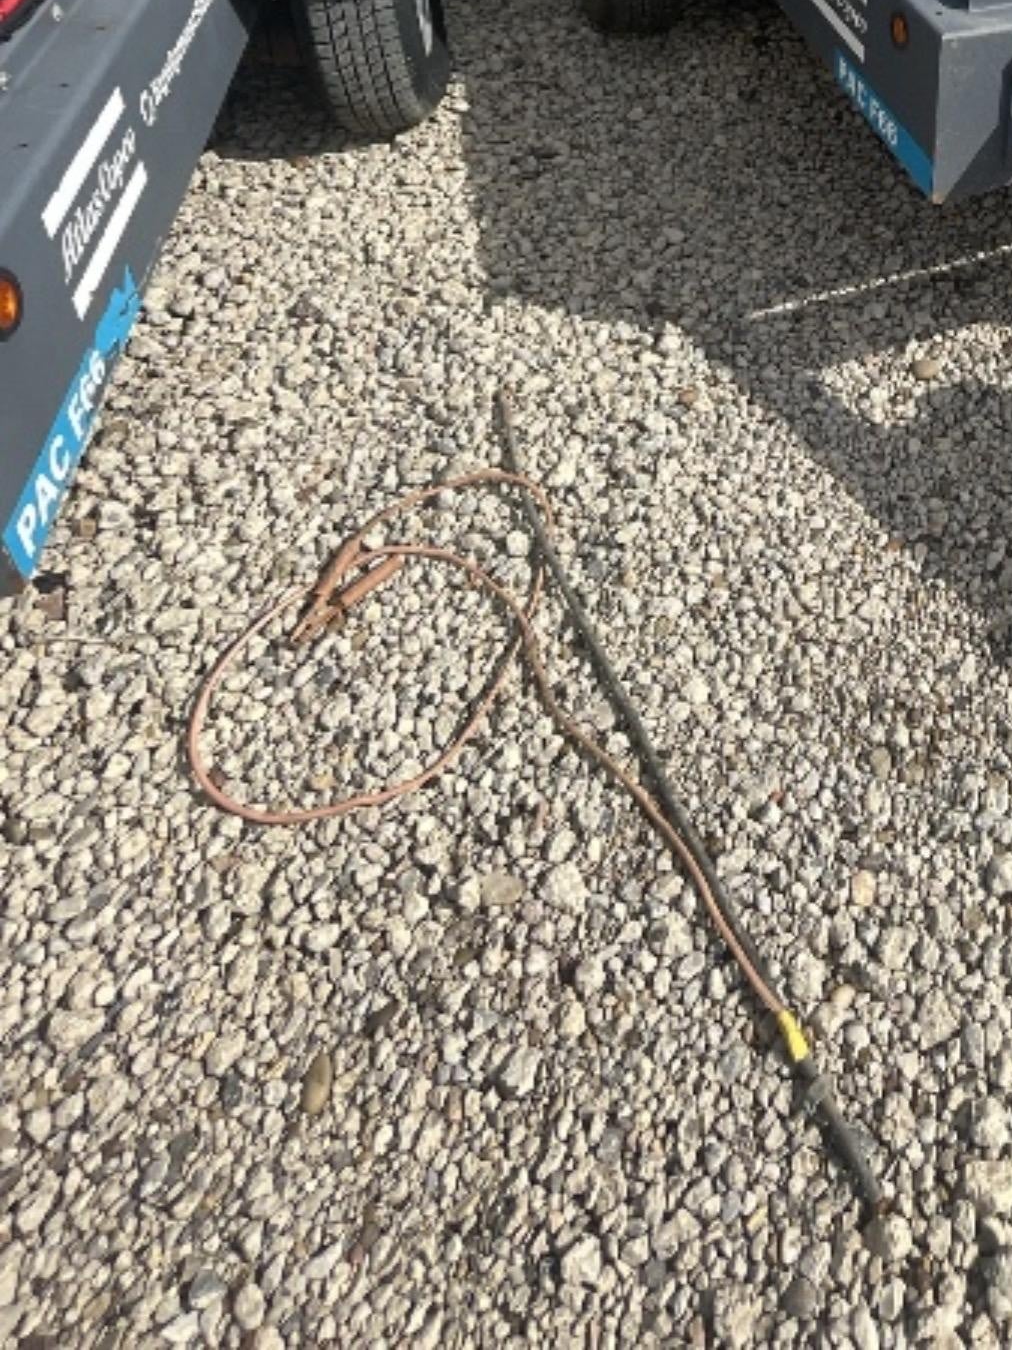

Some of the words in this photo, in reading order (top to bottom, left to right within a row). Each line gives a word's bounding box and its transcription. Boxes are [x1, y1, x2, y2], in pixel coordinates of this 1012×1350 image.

[61, 187, 105, 286] Atlas
[97, 125, 136, 202] Copco
[16, 433, 70, 559] PAC
